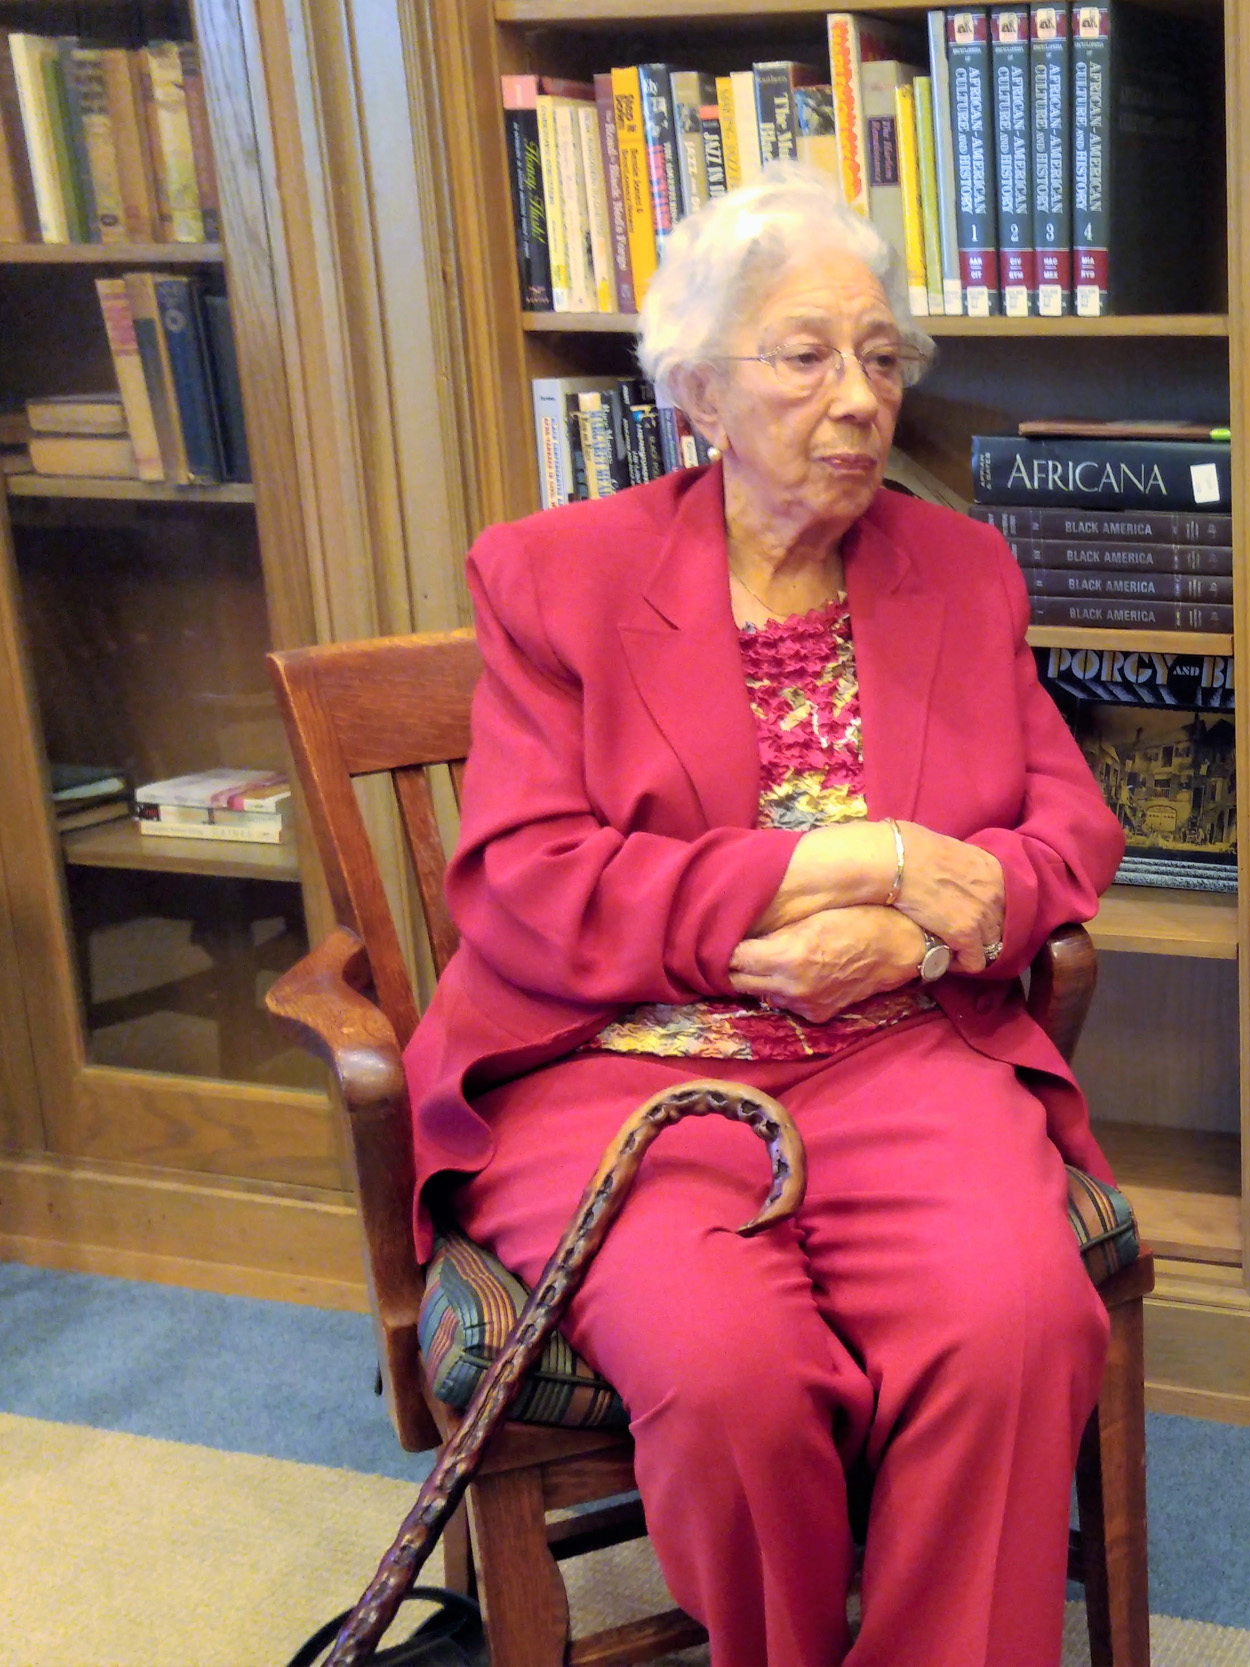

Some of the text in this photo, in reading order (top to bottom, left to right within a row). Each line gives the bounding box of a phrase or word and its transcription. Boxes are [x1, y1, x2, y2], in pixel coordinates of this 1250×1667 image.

[955, 68, 970, 131] CULTURE
[998, 66, 1012, 131] CULTURE
[1035, 65, 1048, 129] CULTURE
[1076, 62, 1087, 127] CULTURE
[702, 131, 722, 165] JAZZ
[760, 122, 776, 162] Blac
[968, 66, 987, 214] AFRICAN-AMERICAN
[1011, 65, 1028, 214] AFRICAN-AMERICAN
[1049, 63, 1064, 214] AFRICAN-AMERICAN
[1089, 61, 1102, 212] AFRICAN-AMERICAN
[958, 154, 973, 214] HISTORY
[1001, 154, 1014, 214] HISTORY
[1036, 153, 1049, 213] HISTORY
[1076, 150, 1087, 212] HISTORY
[971, 224, 979, 242] 1
[1010, 223, 1019, 242] 2
[1046, 223, 1055, 242] 3
[1084, 222, 1093, 241] 4
[1006, 452, 1168, 496] AFRICANA
[1065, 520, 1153, 536] BLACK AMERICA
[1066, 550, 1154, 565] BLACK AMERICA
[1068, 578, 1156, 593] BLACK AMERICA
[1069, 608, 1156, 623] BLACK AMERICA
[1047, 648, 1200, 686] PORGY AND
